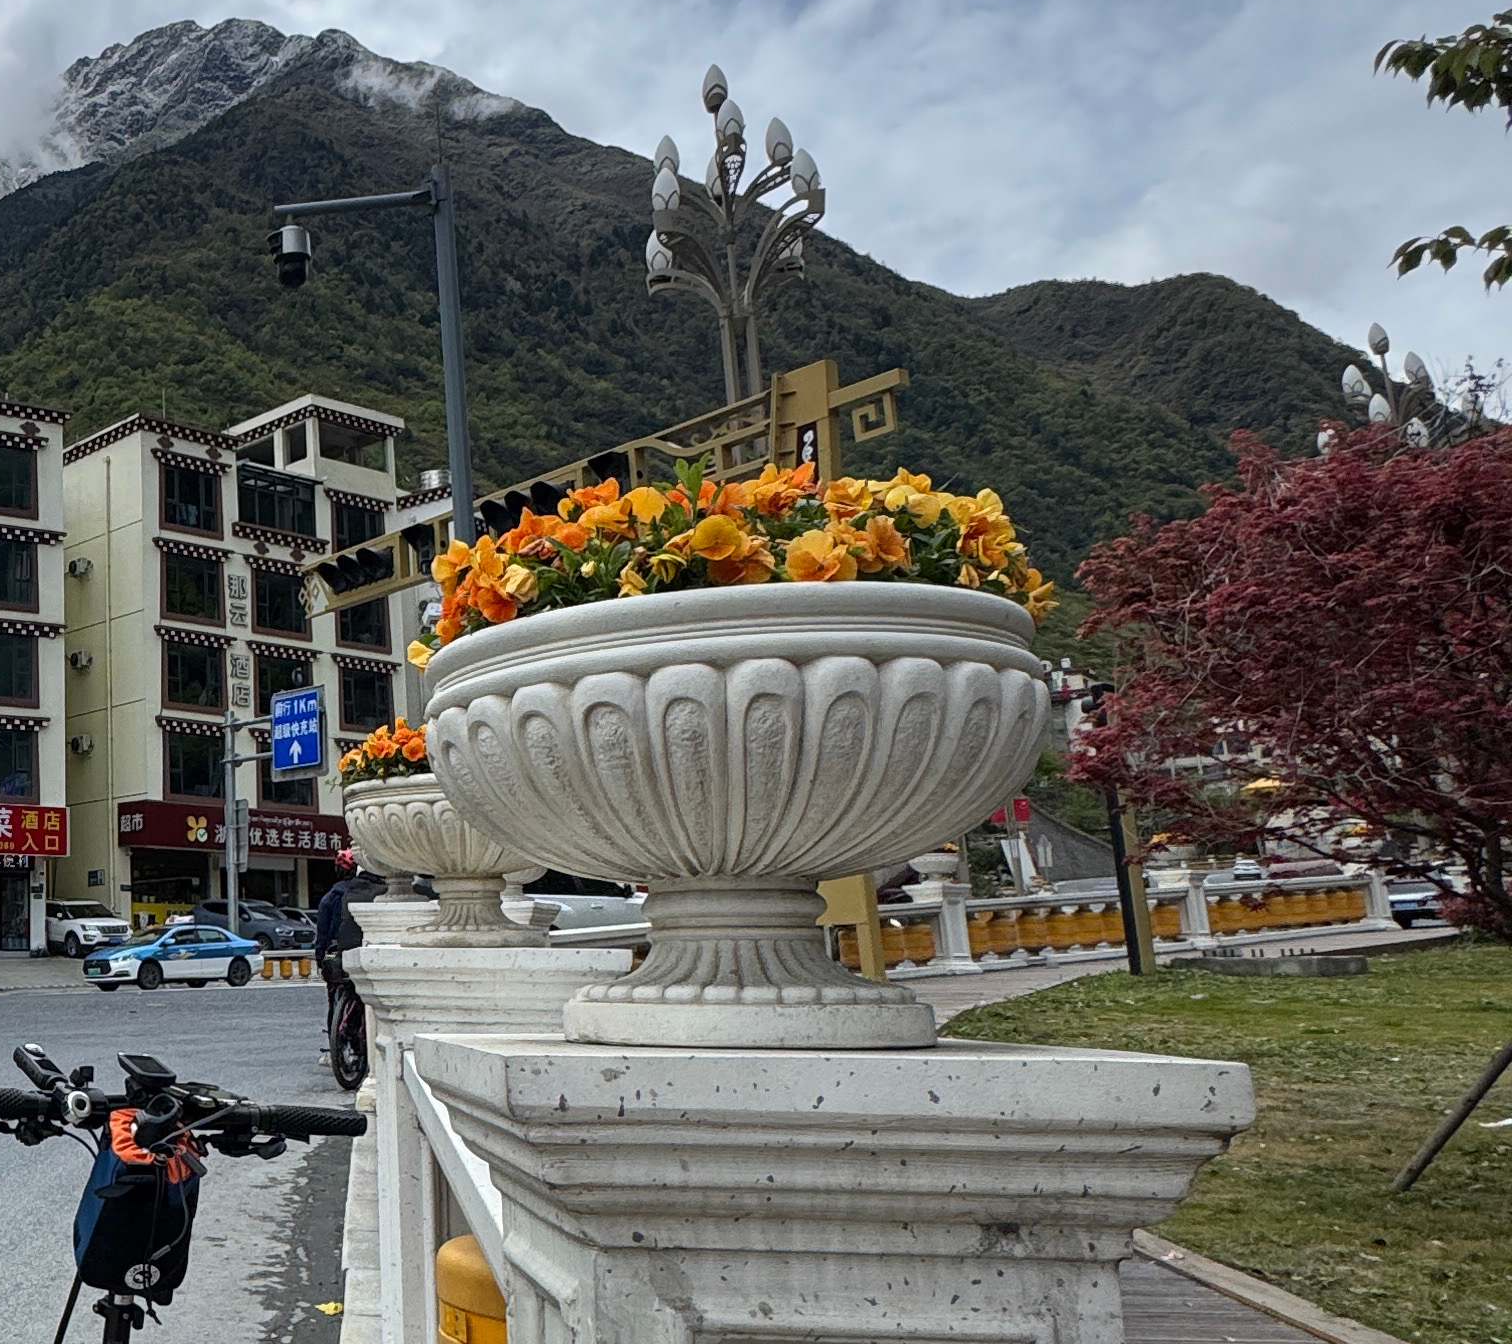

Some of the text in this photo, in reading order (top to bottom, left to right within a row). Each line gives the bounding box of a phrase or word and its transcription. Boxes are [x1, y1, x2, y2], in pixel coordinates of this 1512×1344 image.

[228, 574, 250, 707] 那云酒店
[293, 697, 317, 715] 1Km
[274, 718, 318, 740] 超级快充站
[21, 809, 61, 832] 酒店
[120, 813, 143, 833] 超市
[21, 832, 60, 851] 入口
